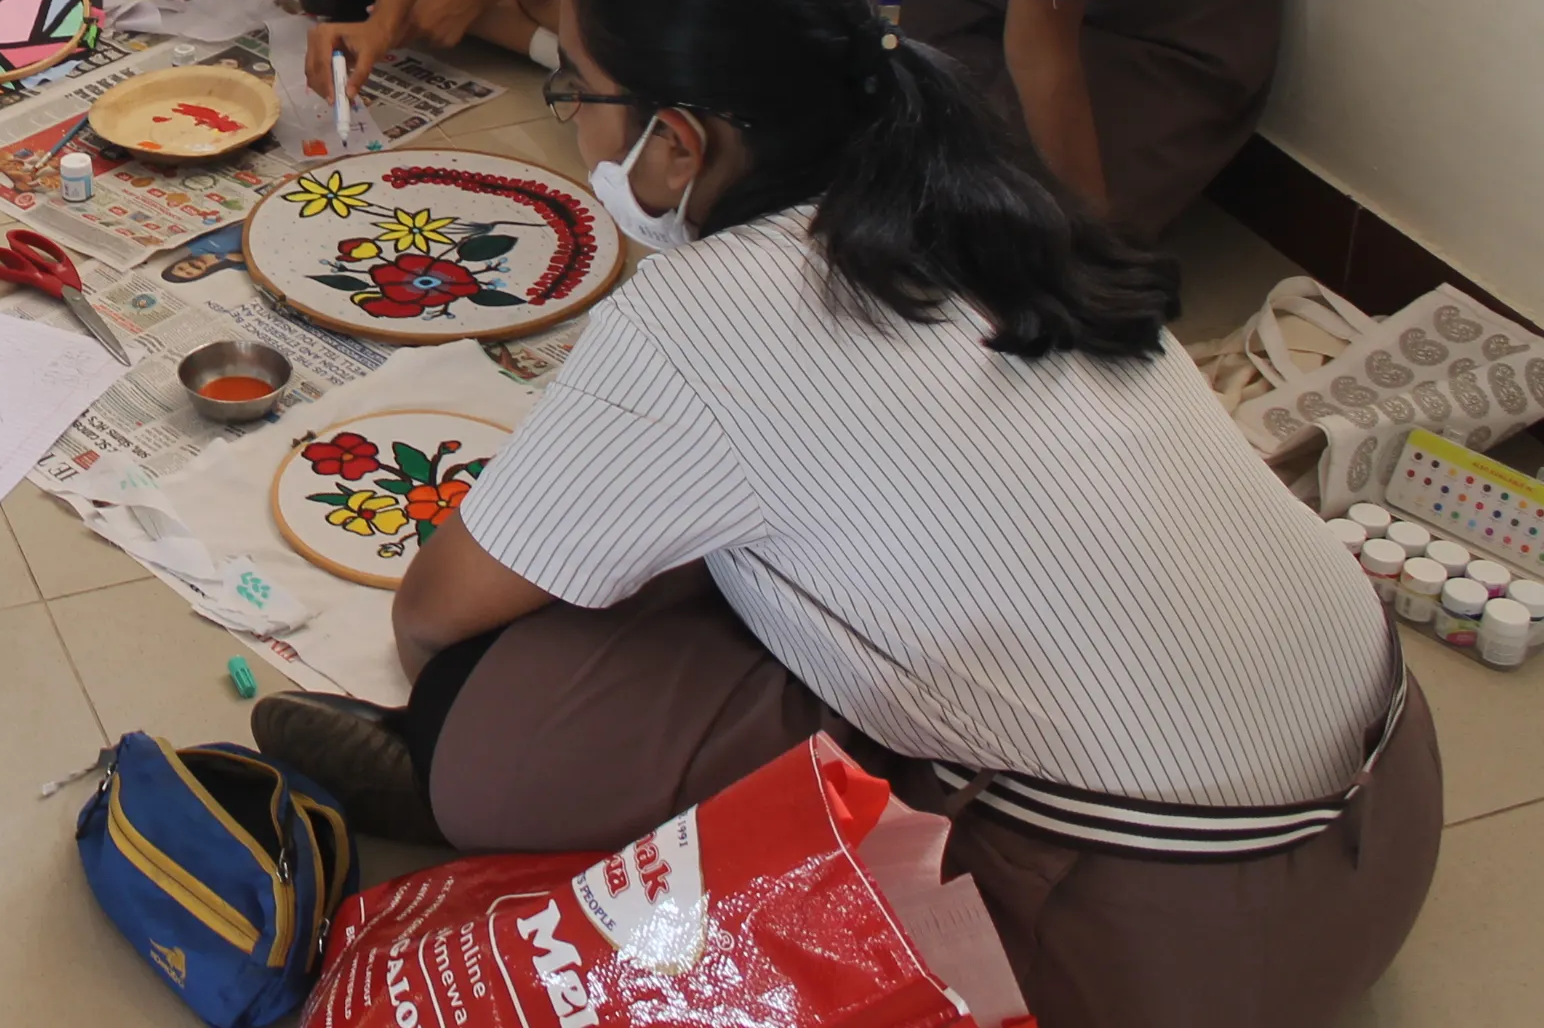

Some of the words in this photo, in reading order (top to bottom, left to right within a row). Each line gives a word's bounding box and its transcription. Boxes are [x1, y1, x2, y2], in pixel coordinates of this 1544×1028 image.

[676, 821, 688, 848] 1991
[579, 886, 617, 932] PEOPLE
[459, 921, 487, 999] online
